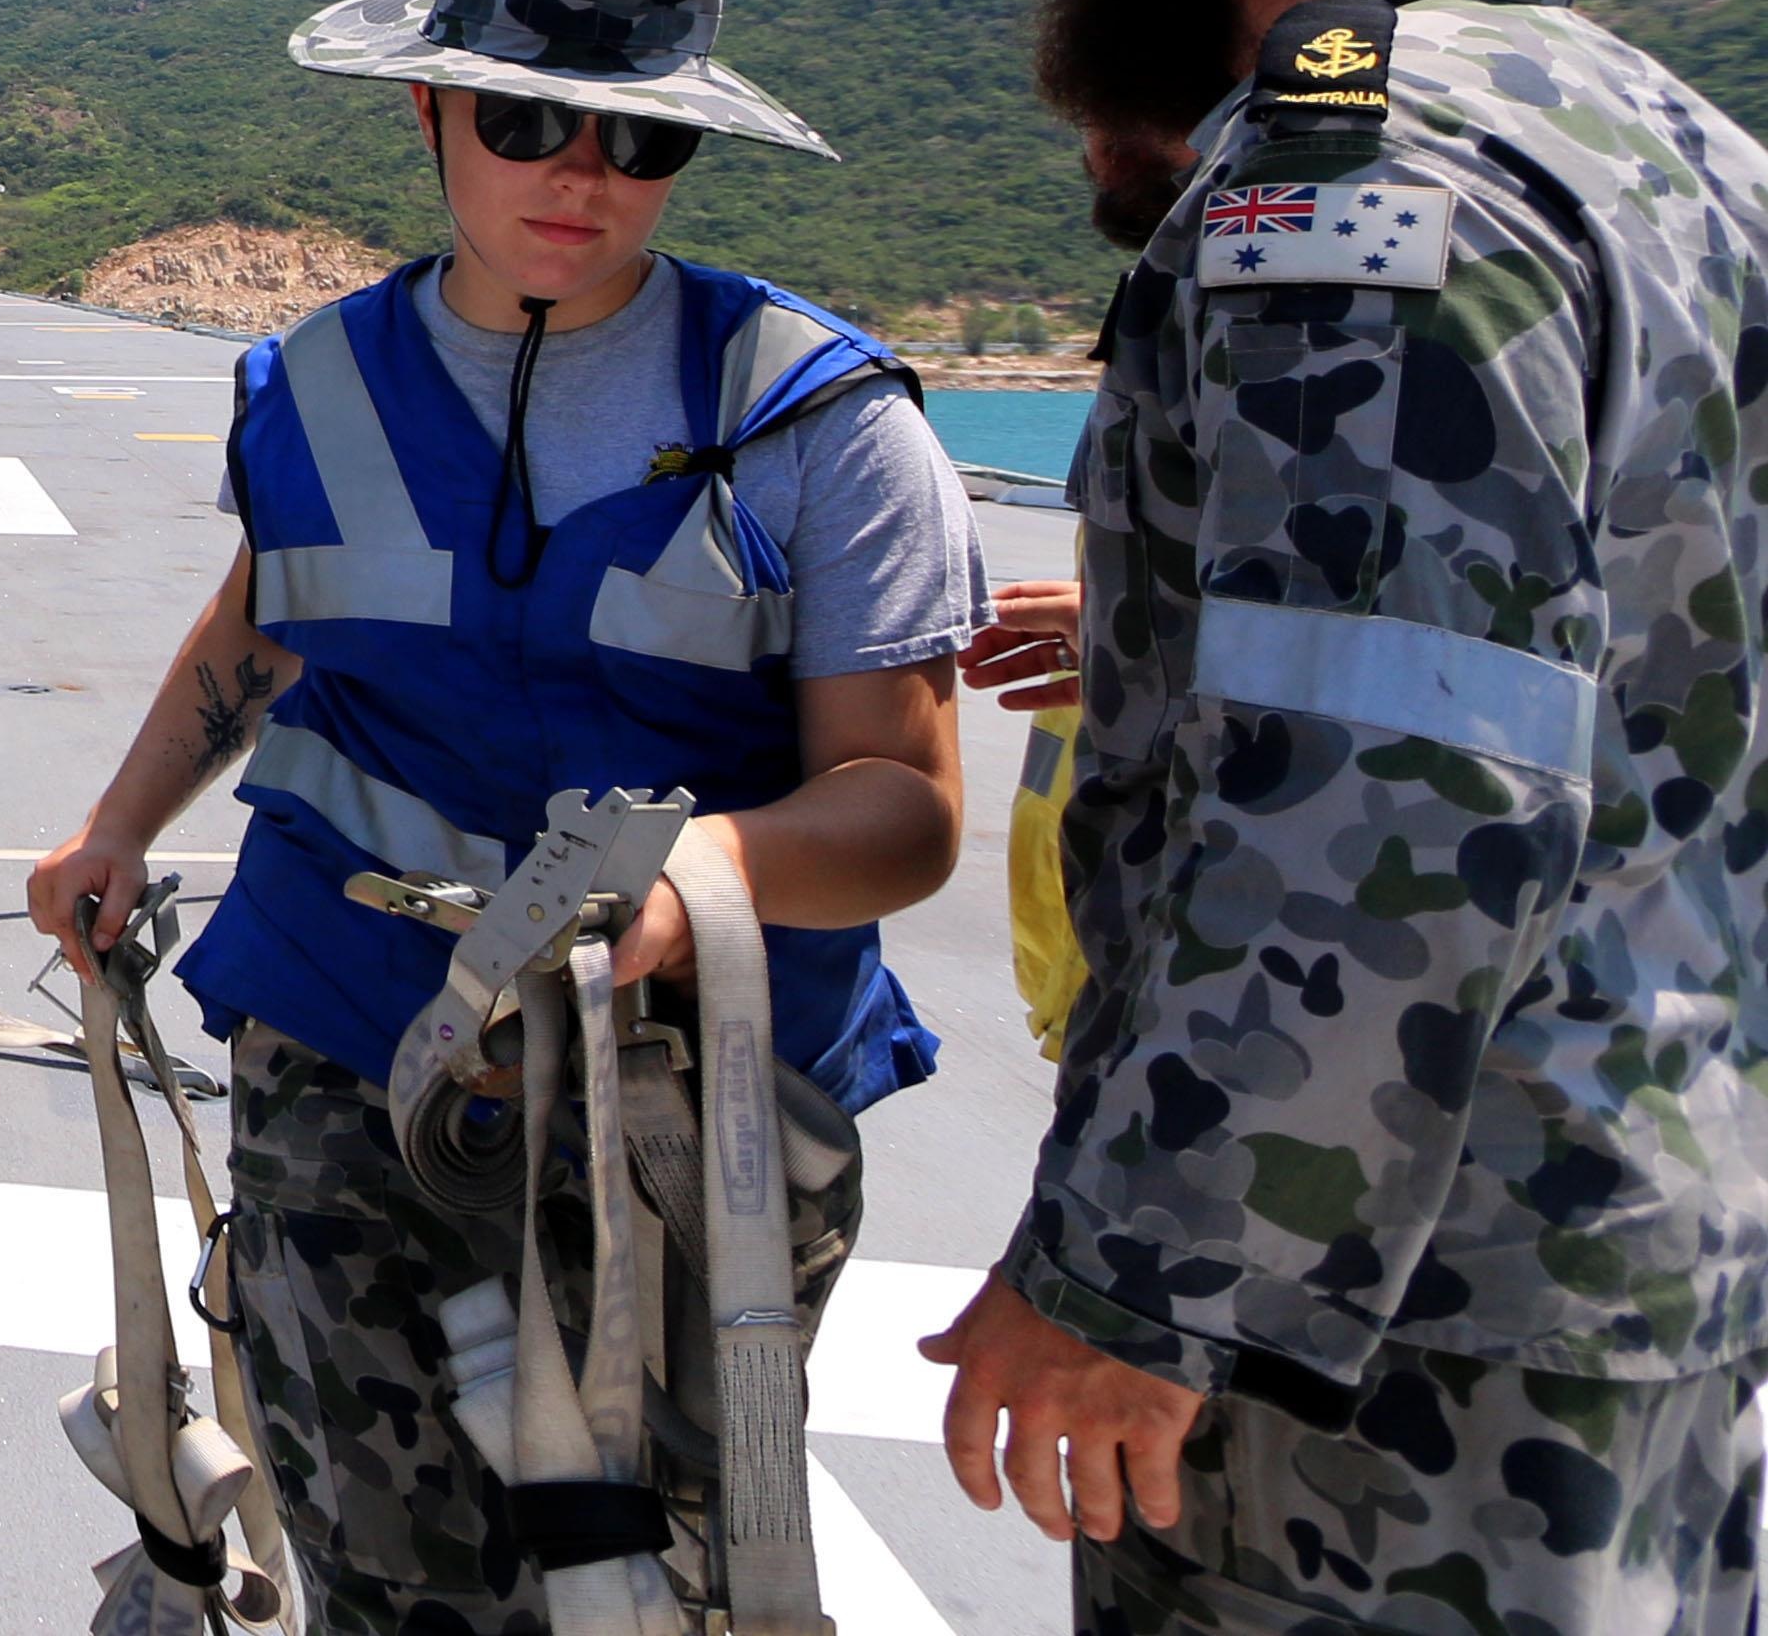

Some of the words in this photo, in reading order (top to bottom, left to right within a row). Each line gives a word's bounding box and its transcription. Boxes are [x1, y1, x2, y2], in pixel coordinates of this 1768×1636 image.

[1274, 90, 1388, 109] AUSTRALIA
[726, 1045, 748, 1104] Aids
[731, 1113, 759, 1190] Cargo
